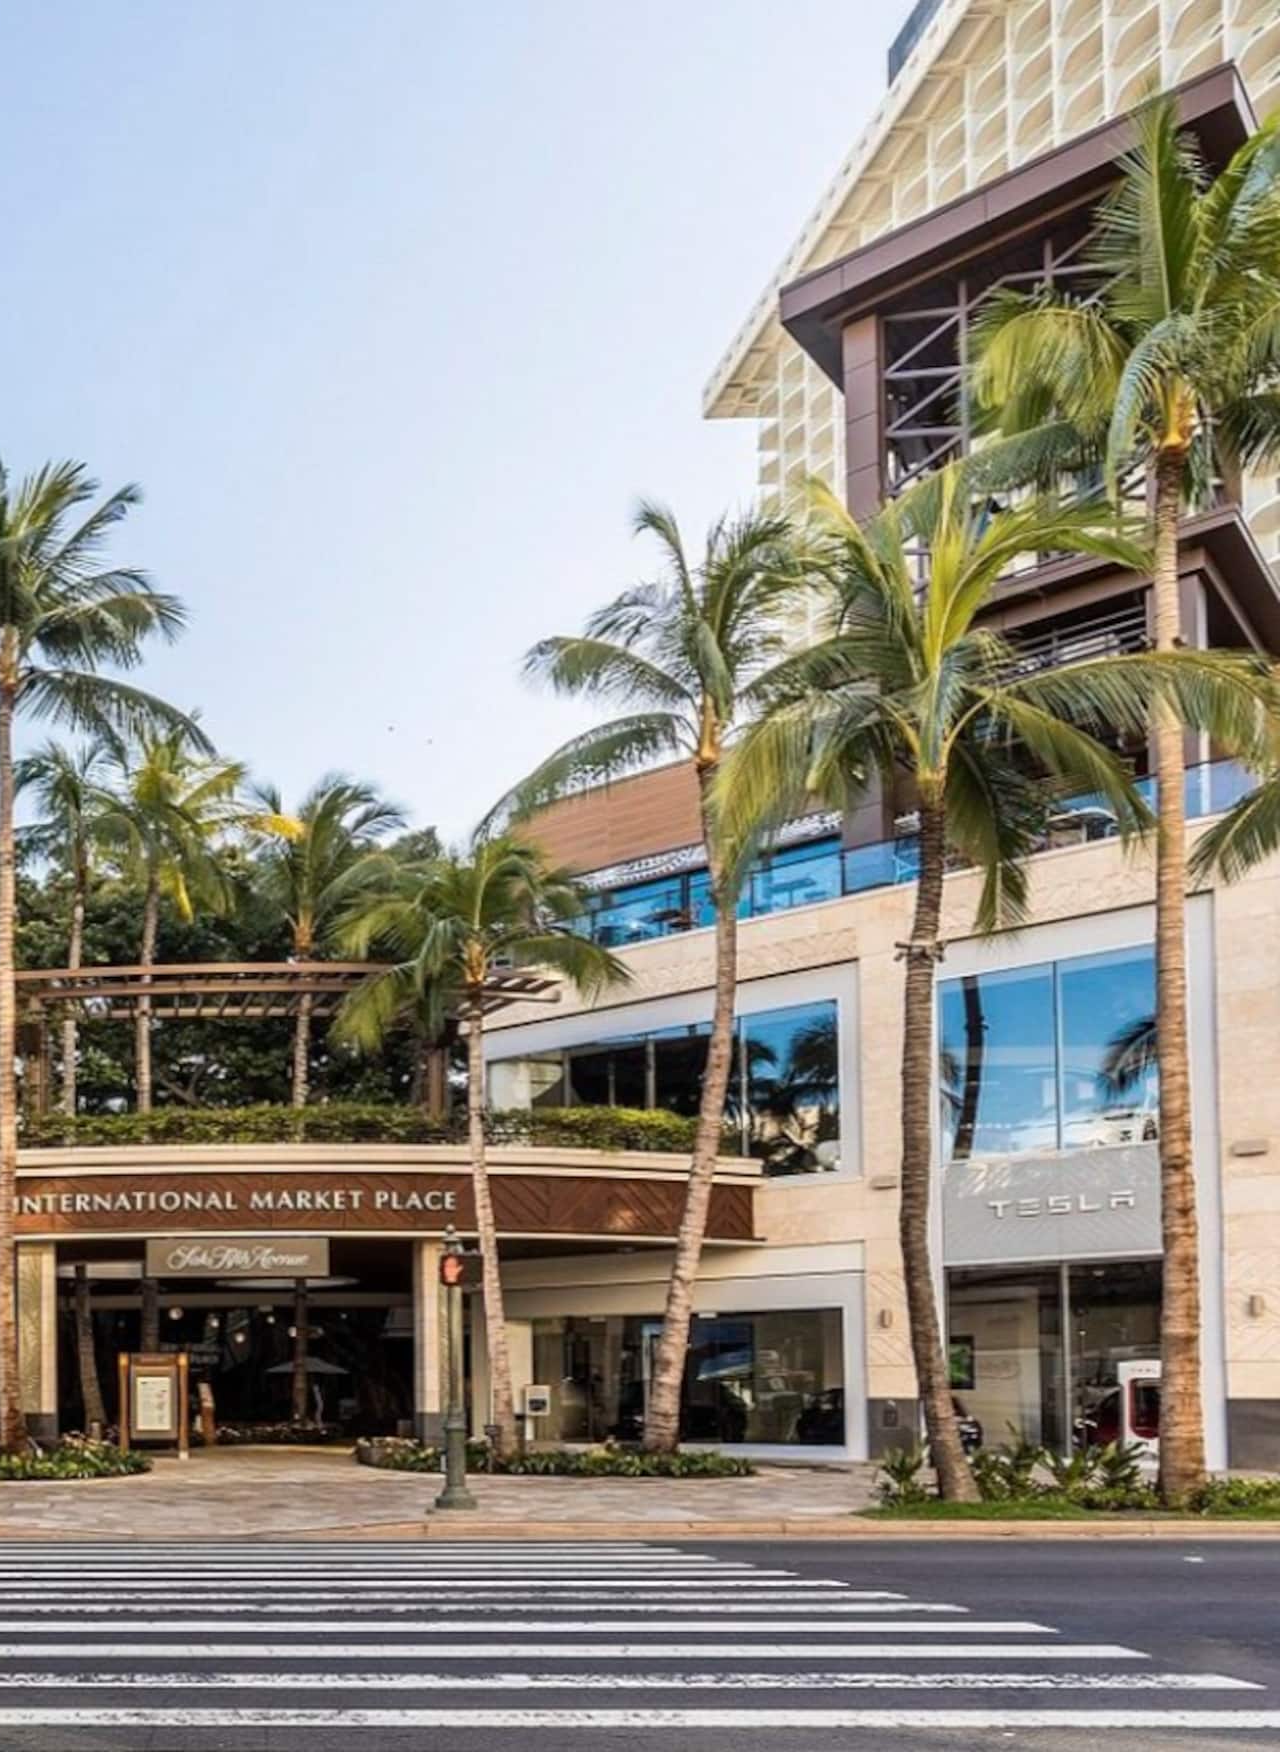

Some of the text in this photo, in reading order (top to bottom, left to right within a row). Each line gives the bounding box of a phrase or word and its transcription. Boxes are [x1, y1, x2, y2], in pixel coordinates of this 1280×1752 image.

[14, 1190, 457, 1215] INTERNATIONAL MARKET PLACE
[987, 1189, 1136, 1219] TESLA
[166, 1244, 310, 1270] Saks Fifth Avenue
